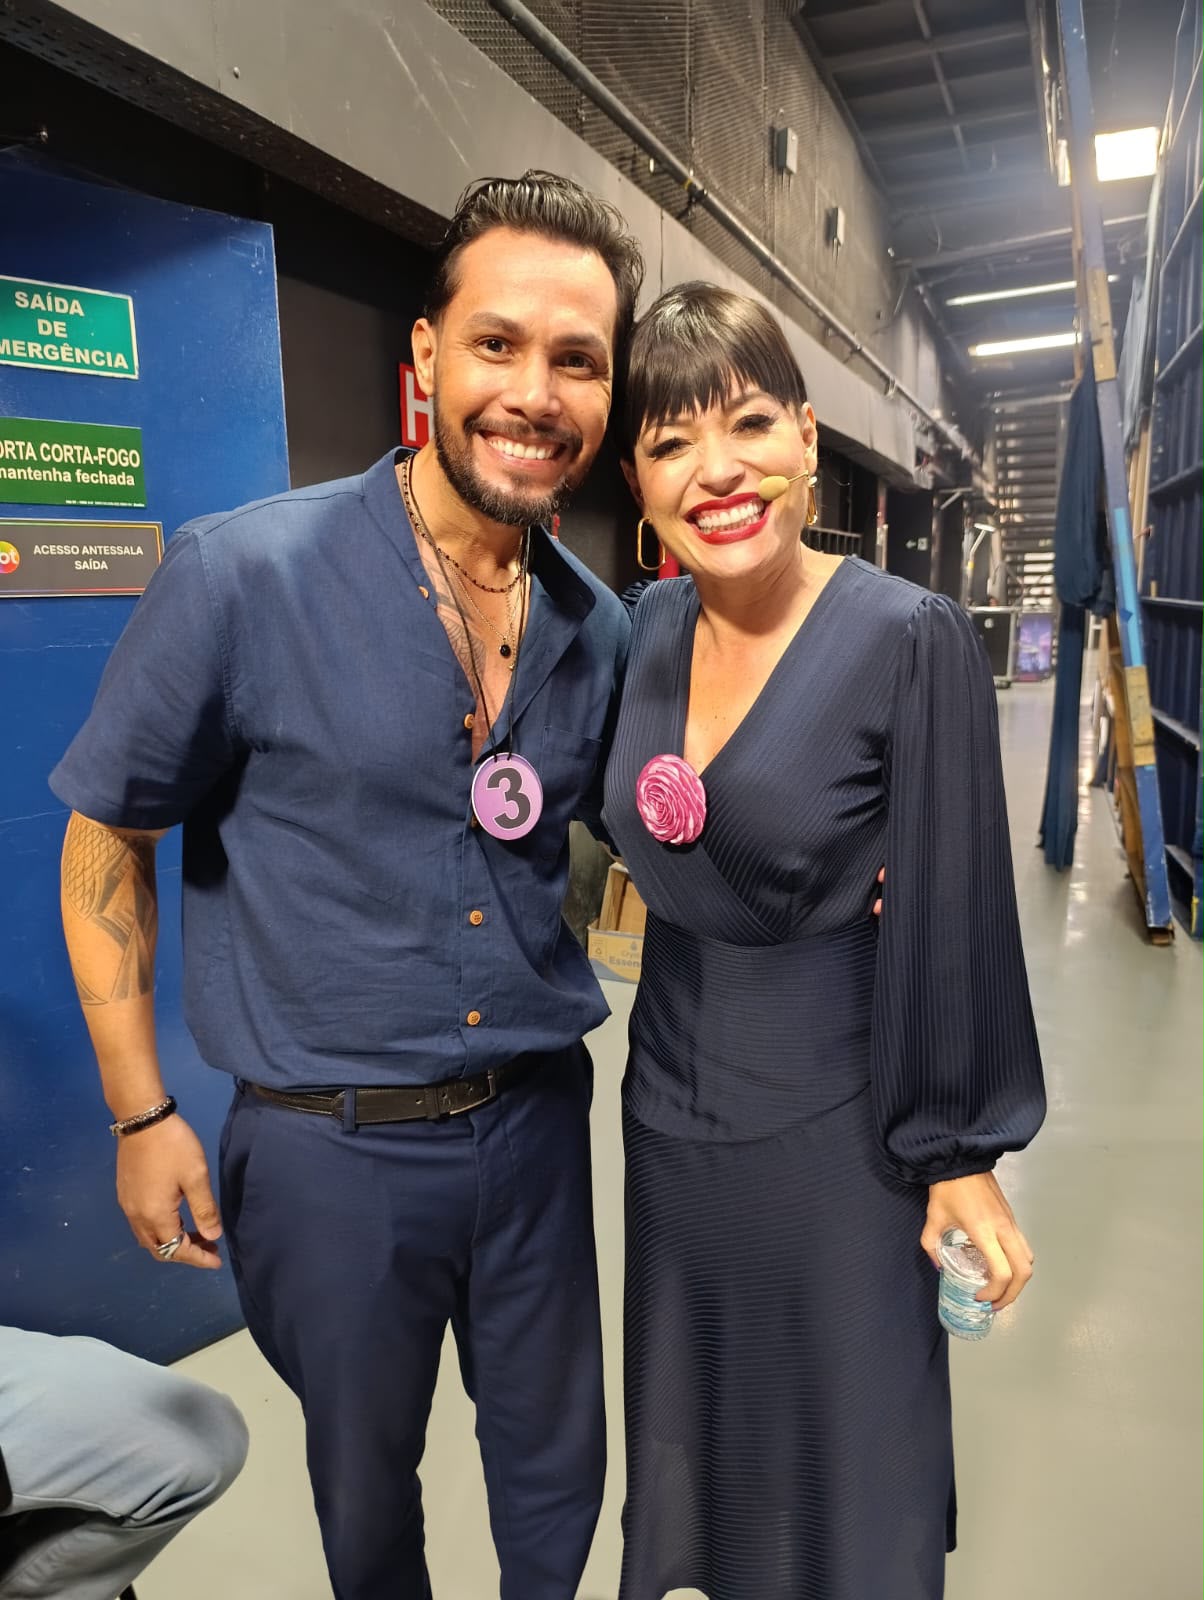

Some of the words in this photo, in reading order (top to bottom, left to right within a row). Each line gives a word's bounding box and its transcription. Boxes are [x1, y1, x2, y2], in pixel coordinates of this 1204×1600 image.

[14, 291, 85, 317] SAÍDA
[37, 318, 68, 338] DE
[39, 442, 141, 468] CORTA-FOGO
[75, 469, 135, 486] fechada
[33, 545, 80, 556] ACESSO
[81, 545, 144, 556] ANTESSALA
[74, 558, 109, 570] SAÍDA
[487, 768, 531, 829] 3
